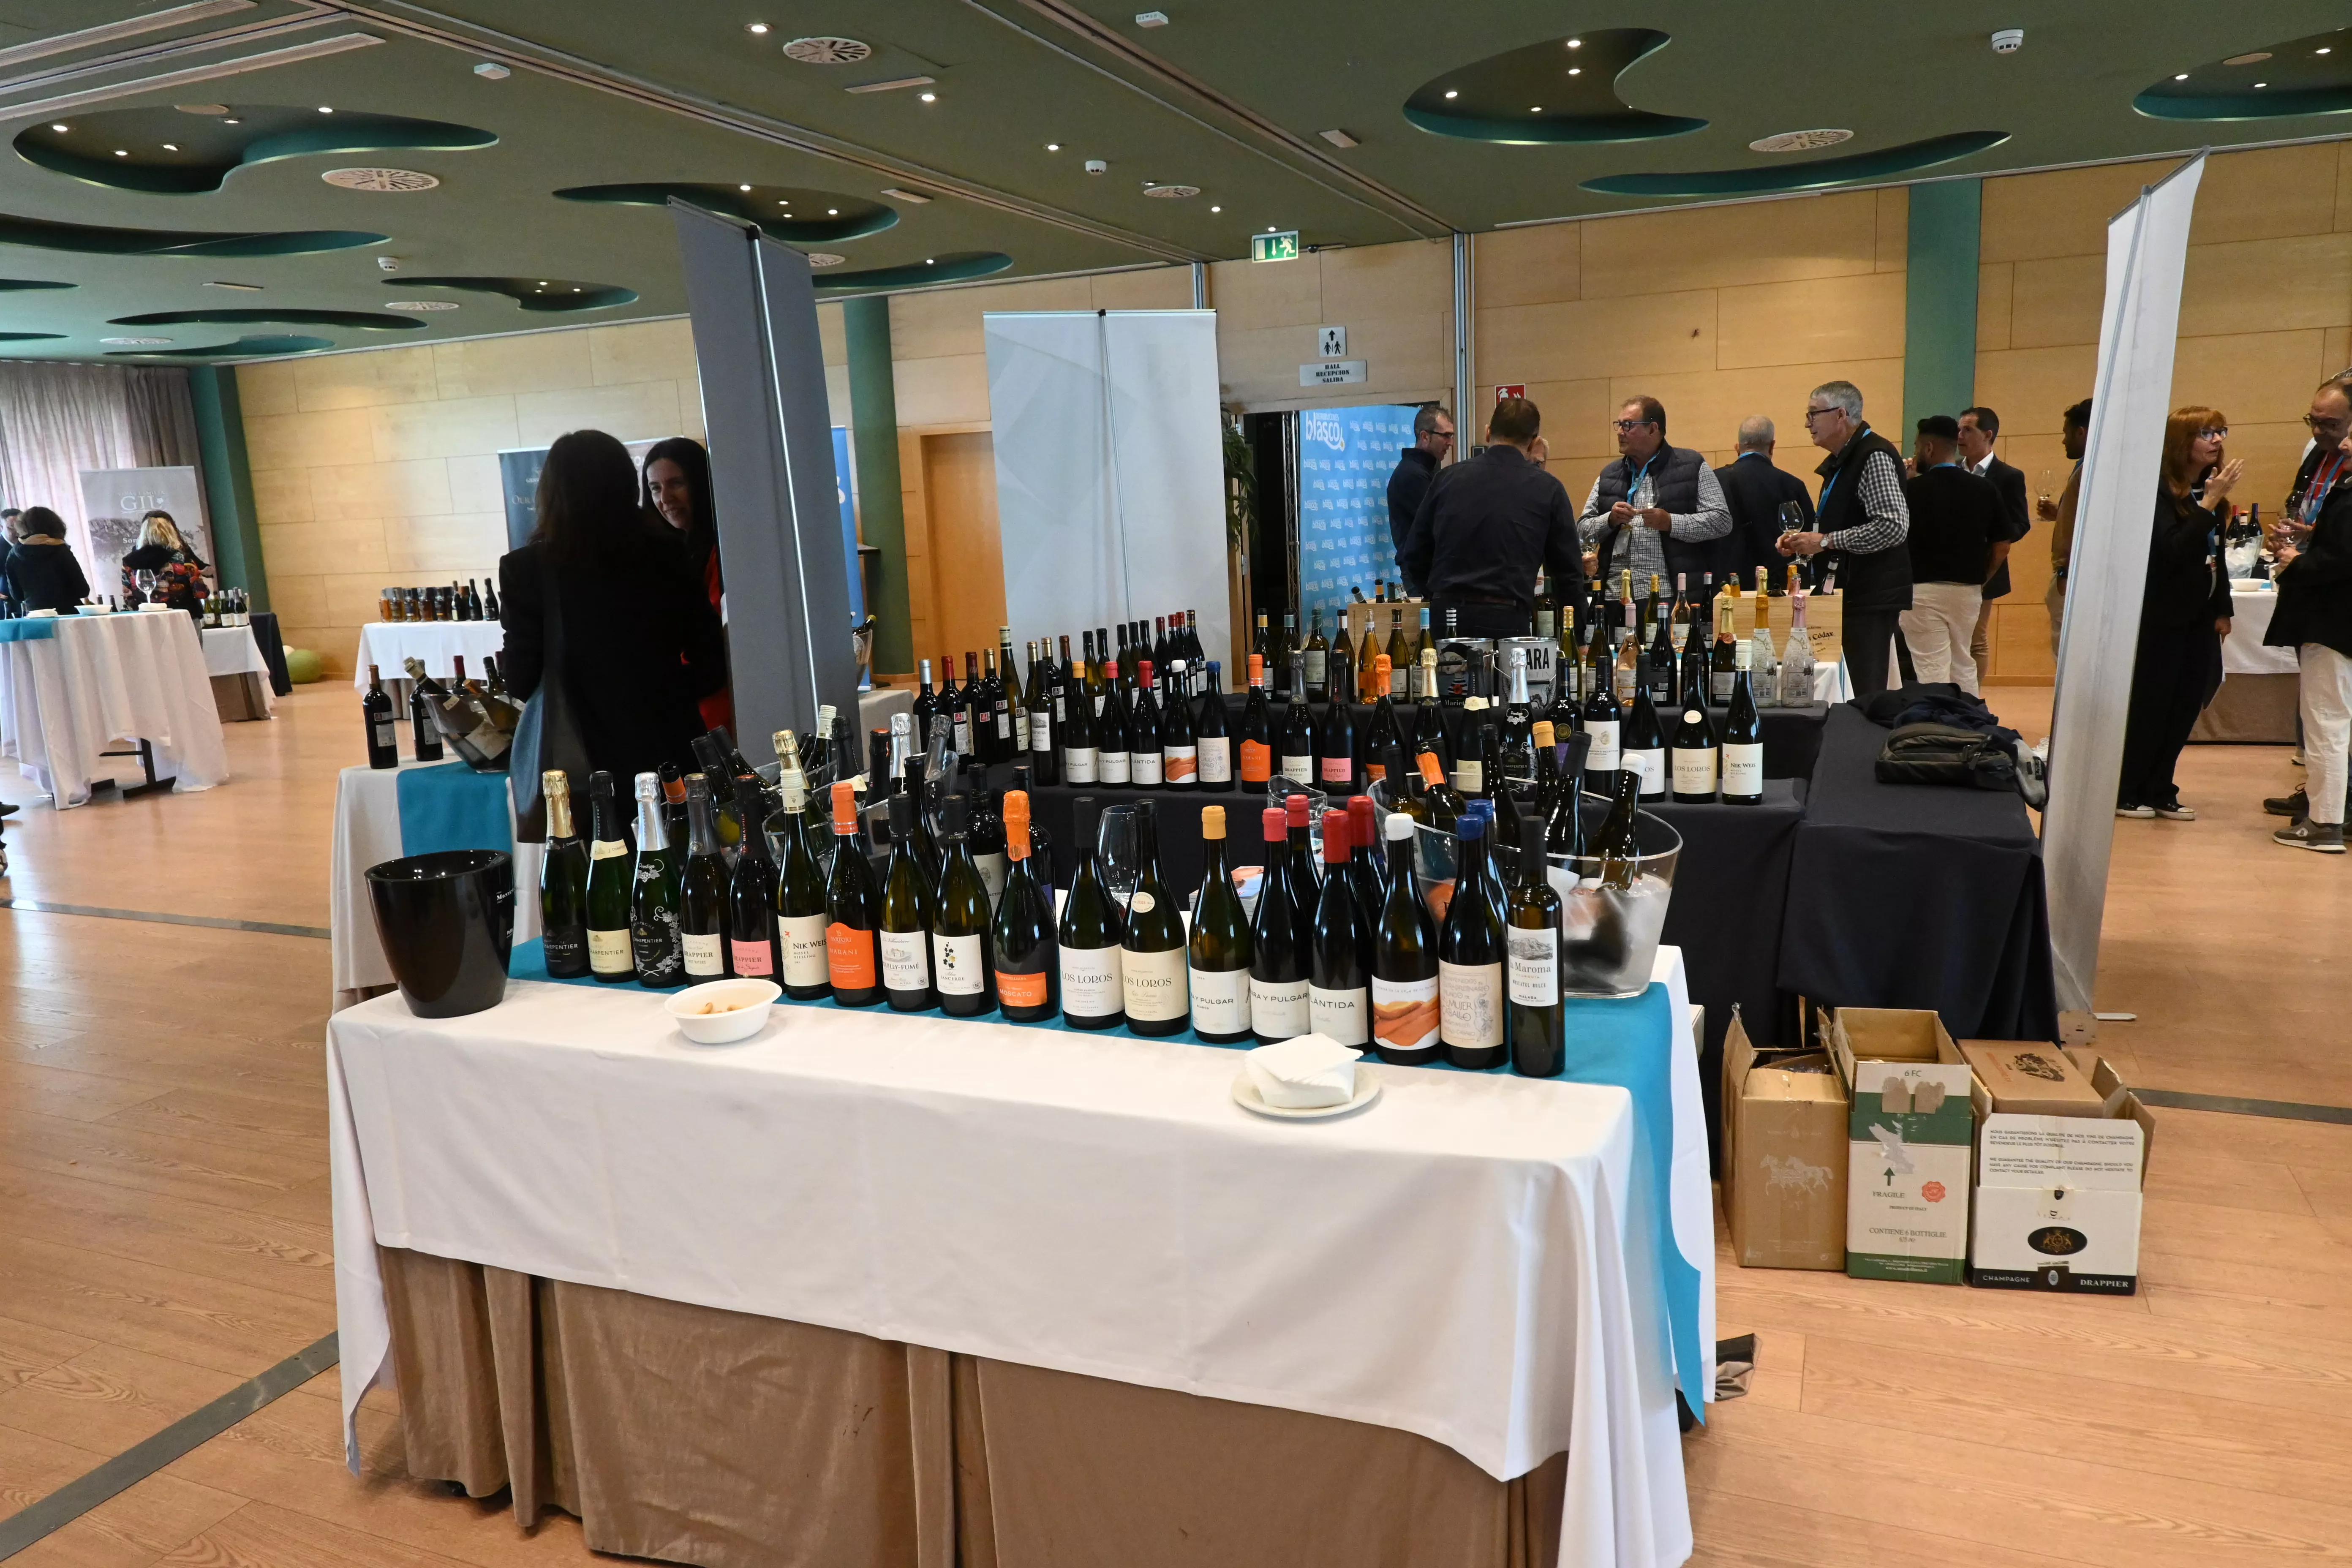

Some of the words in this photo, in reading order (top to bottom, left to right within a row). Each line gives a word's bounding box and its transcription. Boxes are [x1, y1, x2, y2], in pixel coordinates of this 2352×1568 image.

[1306, 411, 1340, 442] blasco
[120, 495, 163, 511] GIL
[1525, 648, 1549, 670] ARA
[639, 862, 655, 870] Prestige
[1515, 961, 1551, 973] Maroma
[1062, 971, 1075, 983] LOS
[1078, 973, 1113, 984] LOROS
[1122, 973, 1134, 986] LOS
[1136, 977, 1172, 988] LOROS
[999, 988, 1032, 997] MOSCATO
[1271, 993, 1307, 1002] PULGAR
[1309, 994, 1355, 1009] LÁNTIDA
[1448, 1000, 1473, 1010] MUJER
[1910, 1230, 1947, 1238] BOTTIGLIE
[1983, 1275, 2030, 1283] CHAMPAGNE
[2080, 1279, 2129, 1288] DRAPPIER
